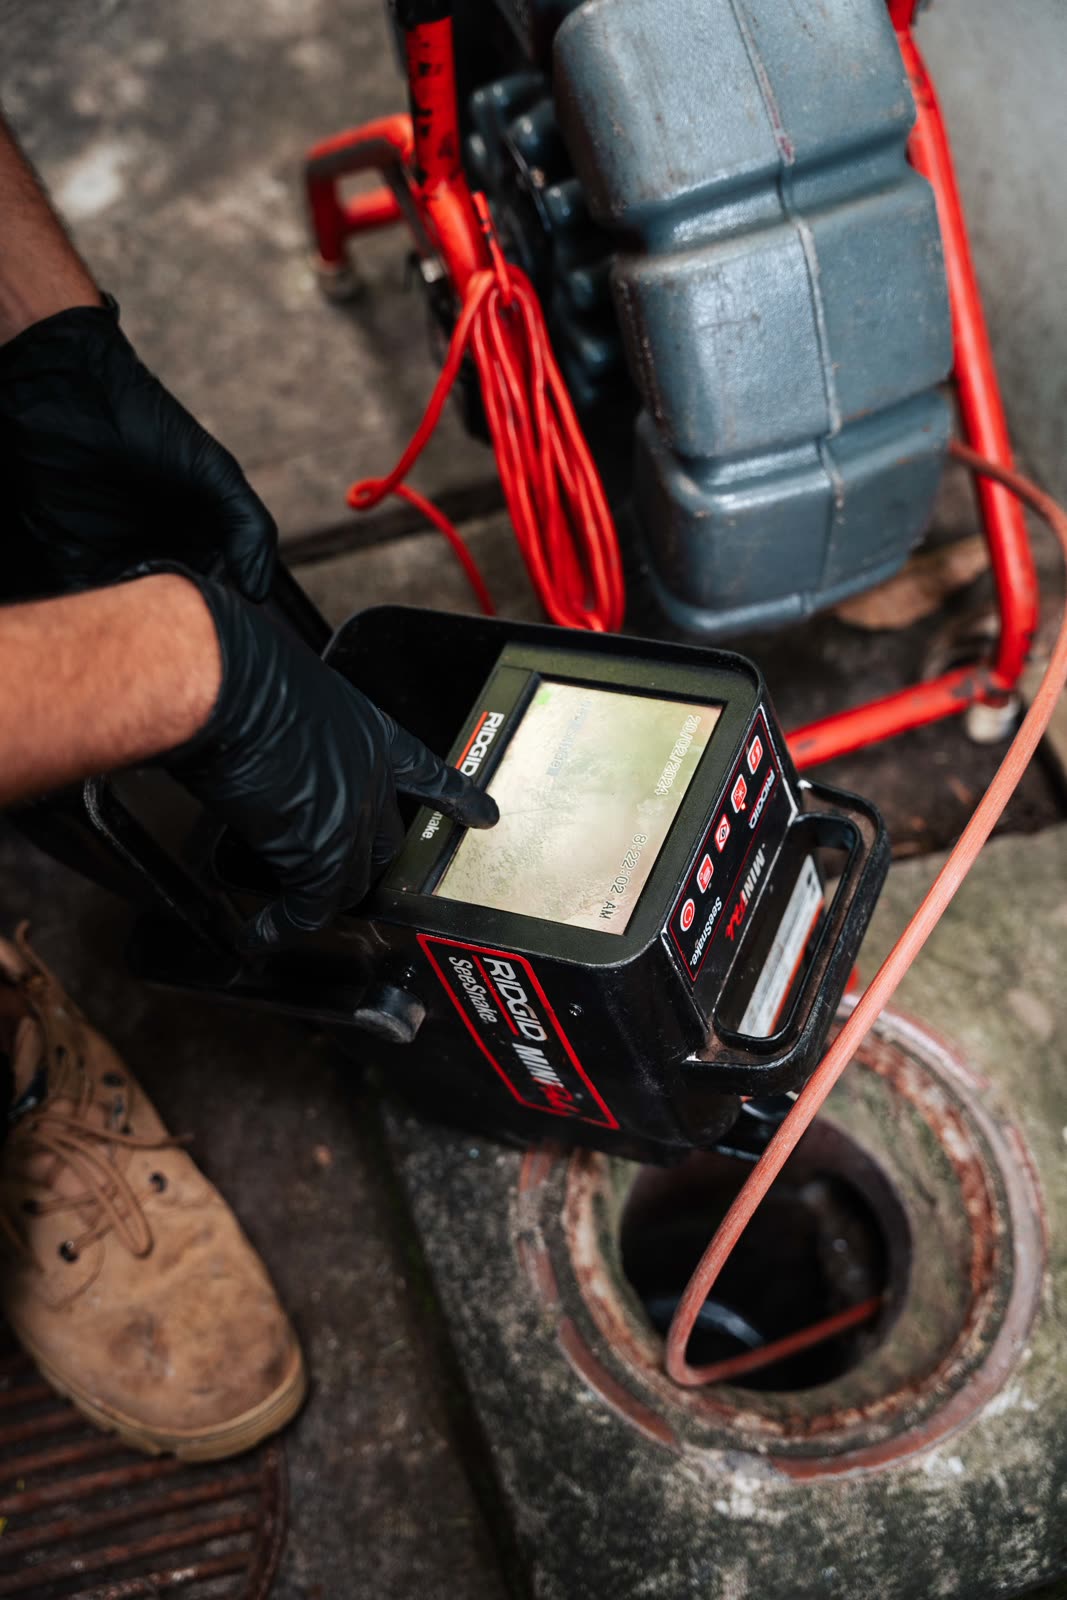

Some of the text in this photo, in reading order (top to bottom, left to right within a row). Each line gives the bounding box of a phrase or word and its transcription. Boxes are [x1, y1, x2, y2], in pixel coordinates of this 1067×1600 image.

[460, 711, 505, 777] RIDGID
[598, 714, 701, 920] 20/02/2024 8:22:02 AM
[749, 767, 776, 830] RIDGID
[448, 956, 498, 1025] SeeSnake
[483, 956, 548, 1042] RIDGID
